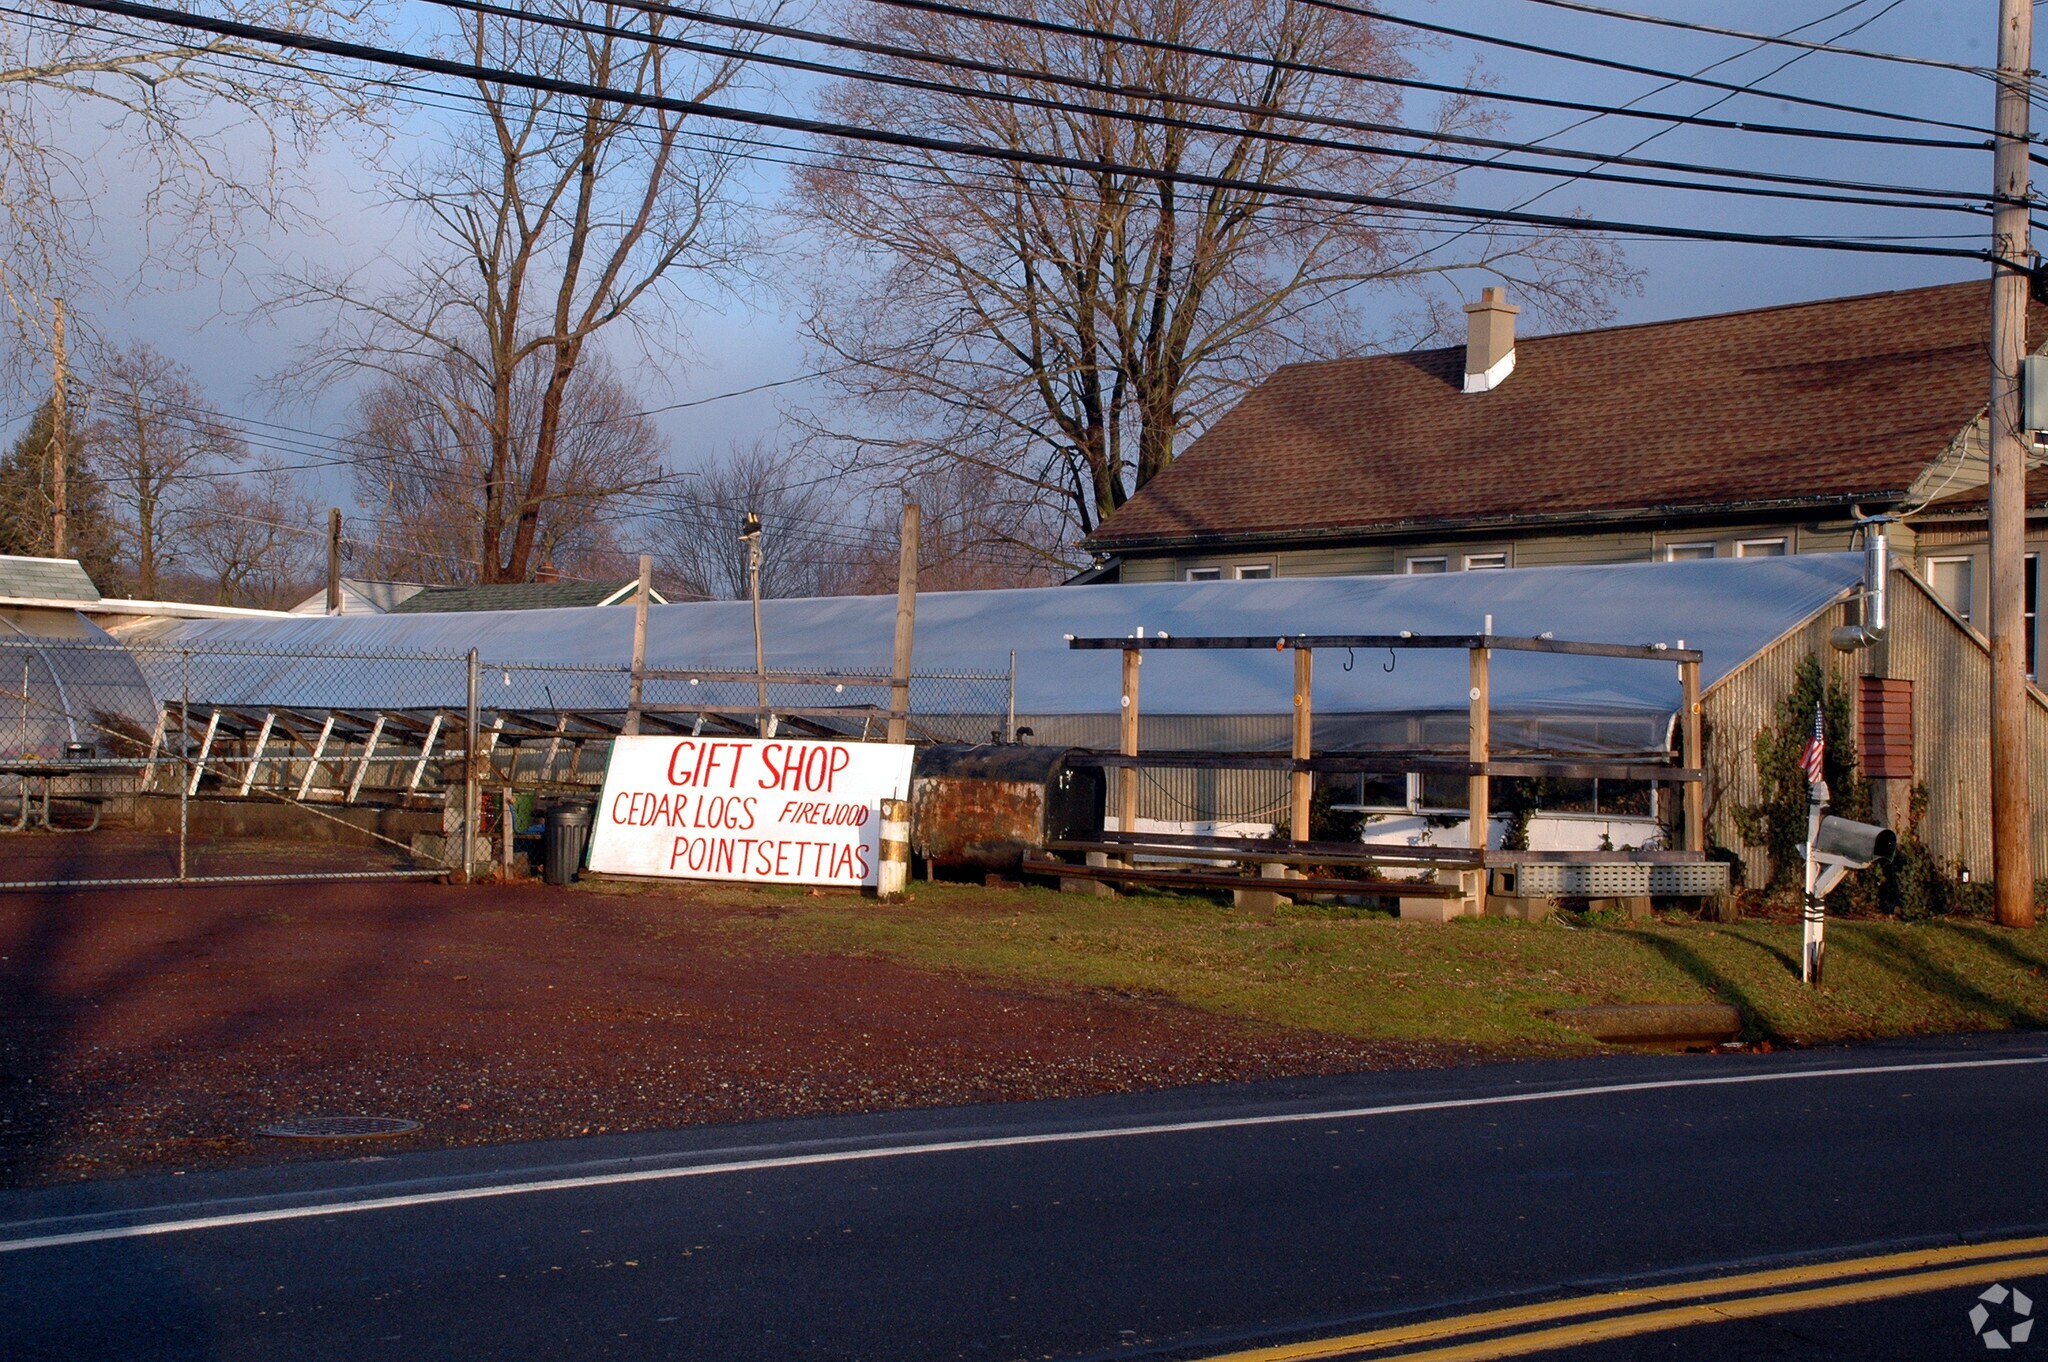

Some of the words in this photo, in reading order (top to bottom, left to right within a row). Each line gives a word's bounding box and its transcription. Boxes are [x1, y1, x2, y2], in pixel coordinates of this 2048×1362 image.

[667, 741, 753, 789] GIFT
[758, 743, 850, 793] SHOP
[612, 791, 688, 828] CEDAR
[693, 795, 758, 831] LOGS
[777, 801, 869, 827] FIREWOOD
[670, 836, 870, 880] POINTSETTIAS
